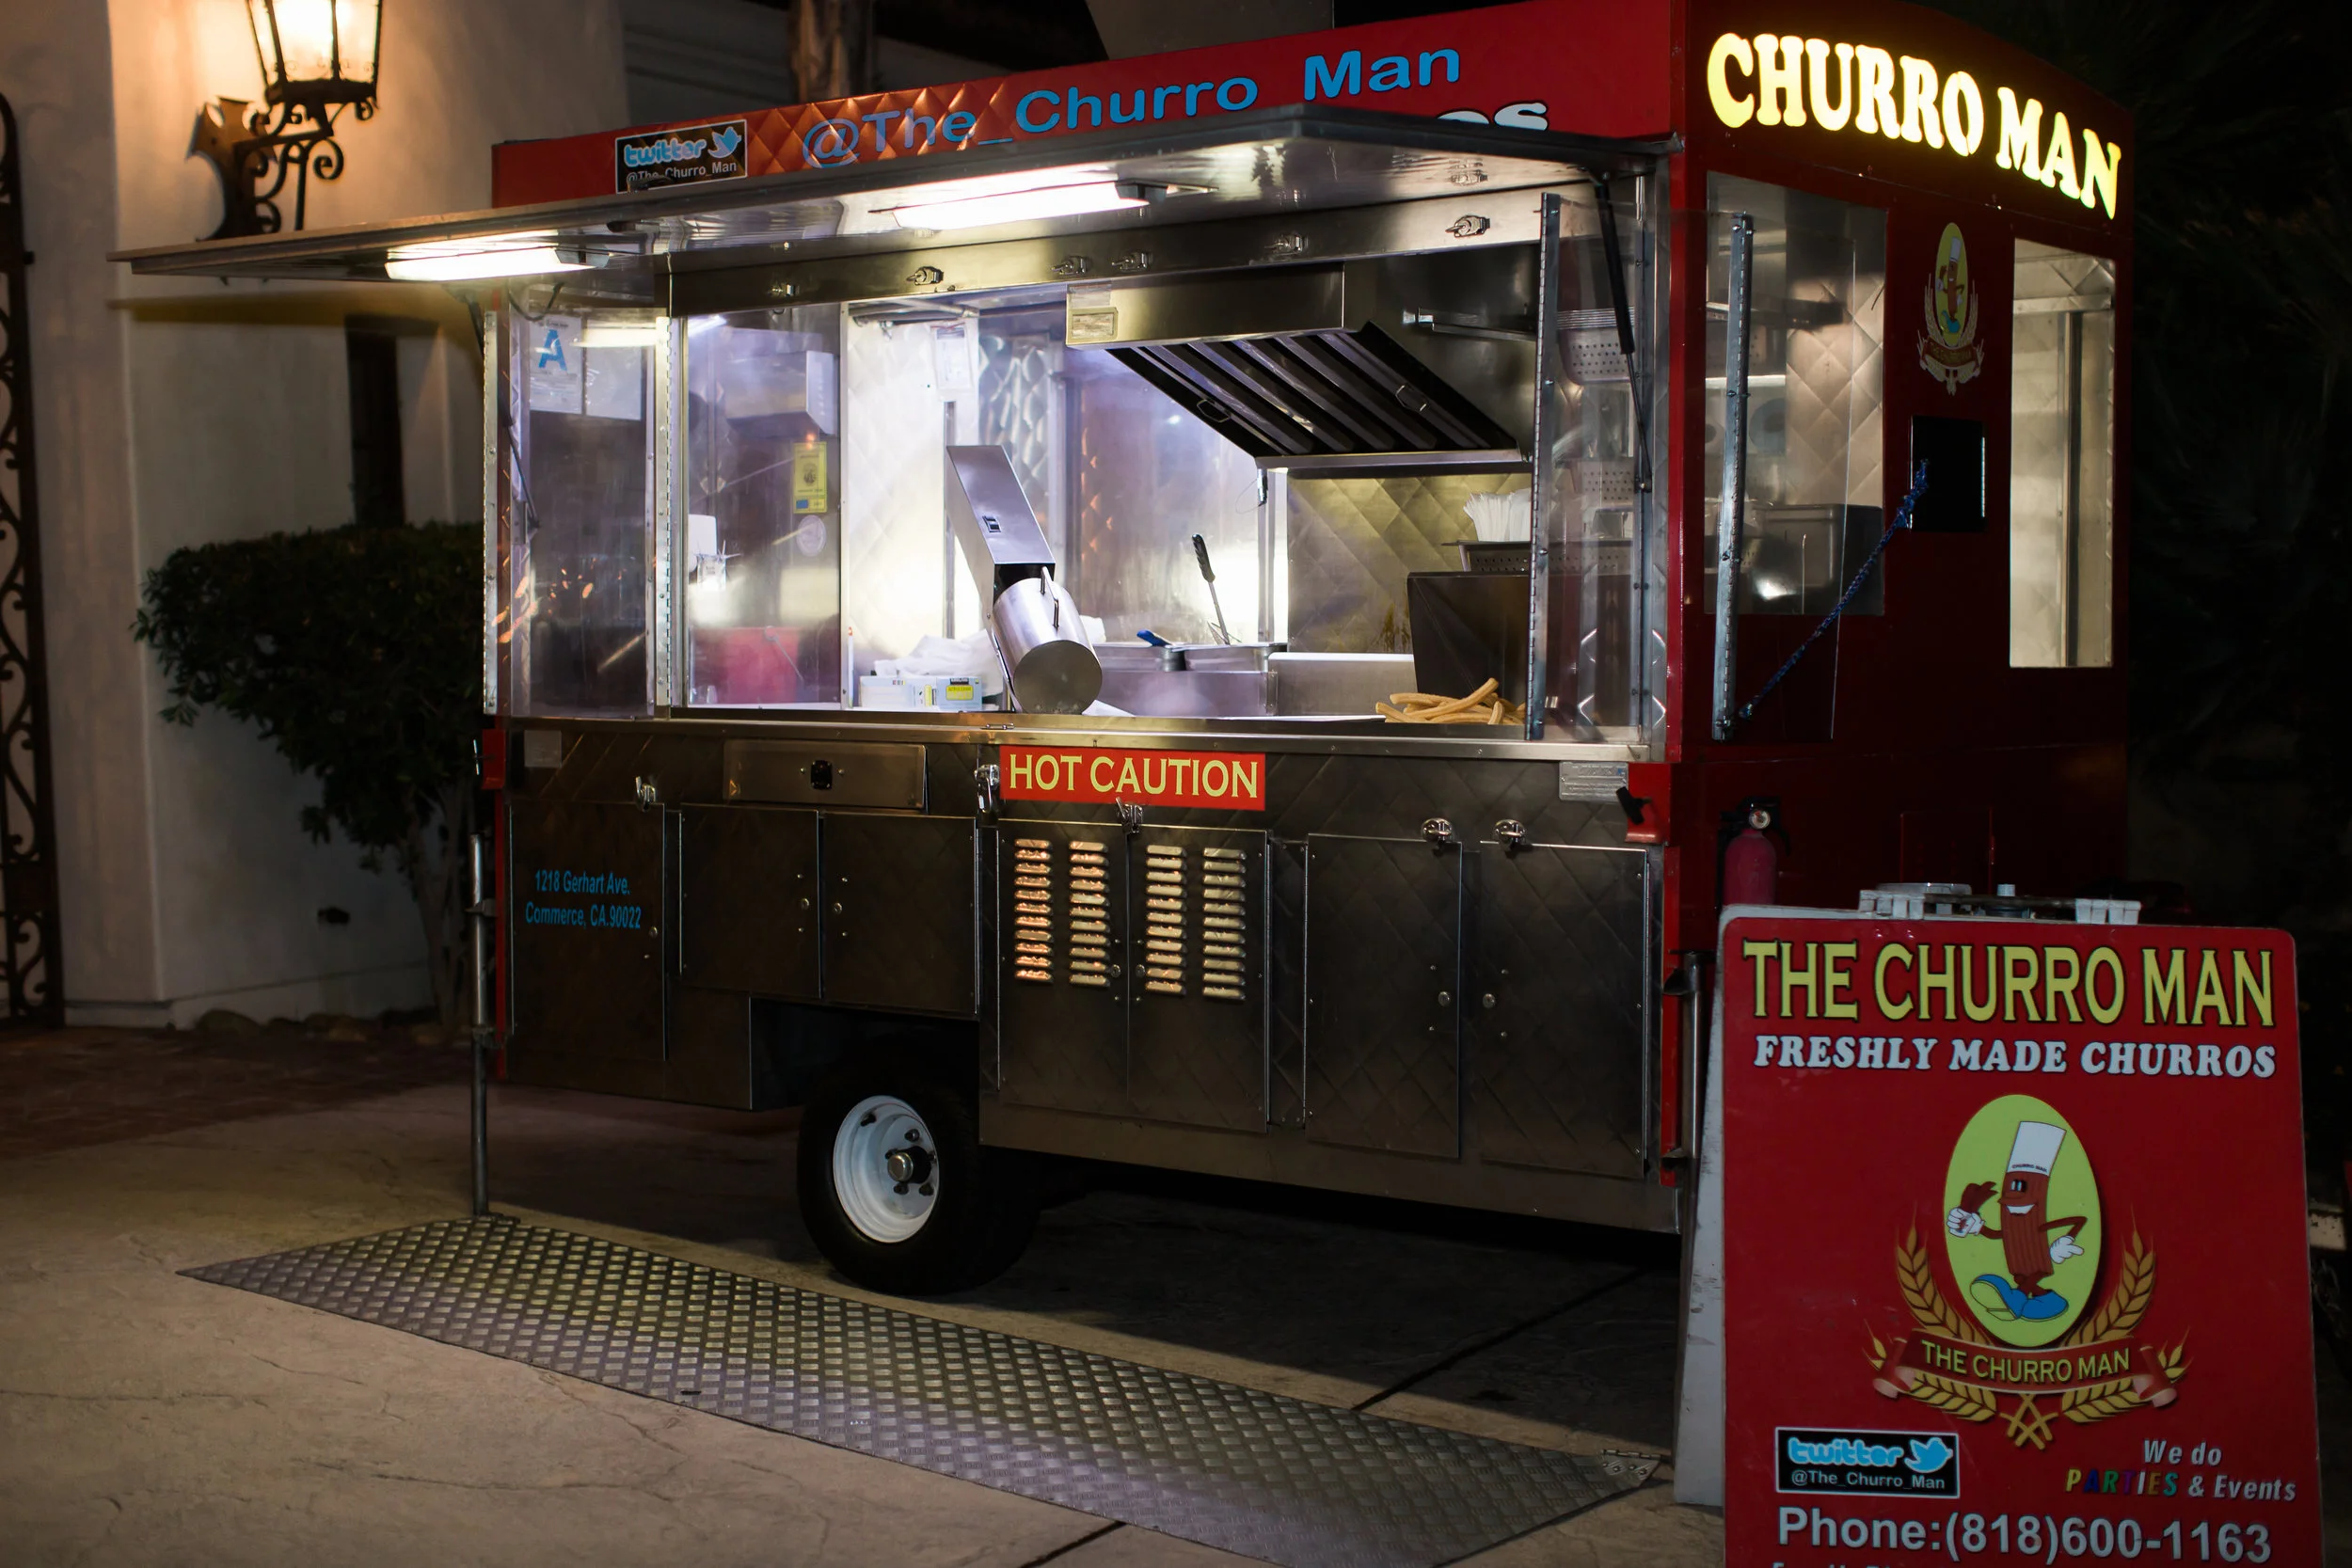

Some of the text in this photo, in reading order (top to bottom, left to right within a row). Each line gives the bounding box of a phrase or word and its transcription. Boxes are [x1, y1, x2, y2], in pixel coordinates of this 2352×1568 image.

[1303, 47, 1461, 102] Man
[1707, 32, 2122, 221] CHURRO MAN
[624, 137, 707, 167] twitter
[627, 162, 737, 183] @TheChurro_Man
[538, 329, 567, 372] A
[1009, 753, 1260, 799] HOT CAUTION
[534, 869, 630, 895] 1218 Gerhart Ave.
[525, 901, 587, 929] Commerce,
[1742, 940, 2275, 1026] THE CHURRO MAN
[1753, 1035, 2277, 1079] FRESHLY MADE CHURROS
[1921, 1339, 2130, 1384] THE CHURRO MAN
[1788, 1437, 1904, 1467] twitter
[2143, 1438, 2223, 1466] We do
[1791, 1469, 1946, 1490] @The_Churro_Man
[2065, 1467, 2297, 1502] PARTIES & Events
